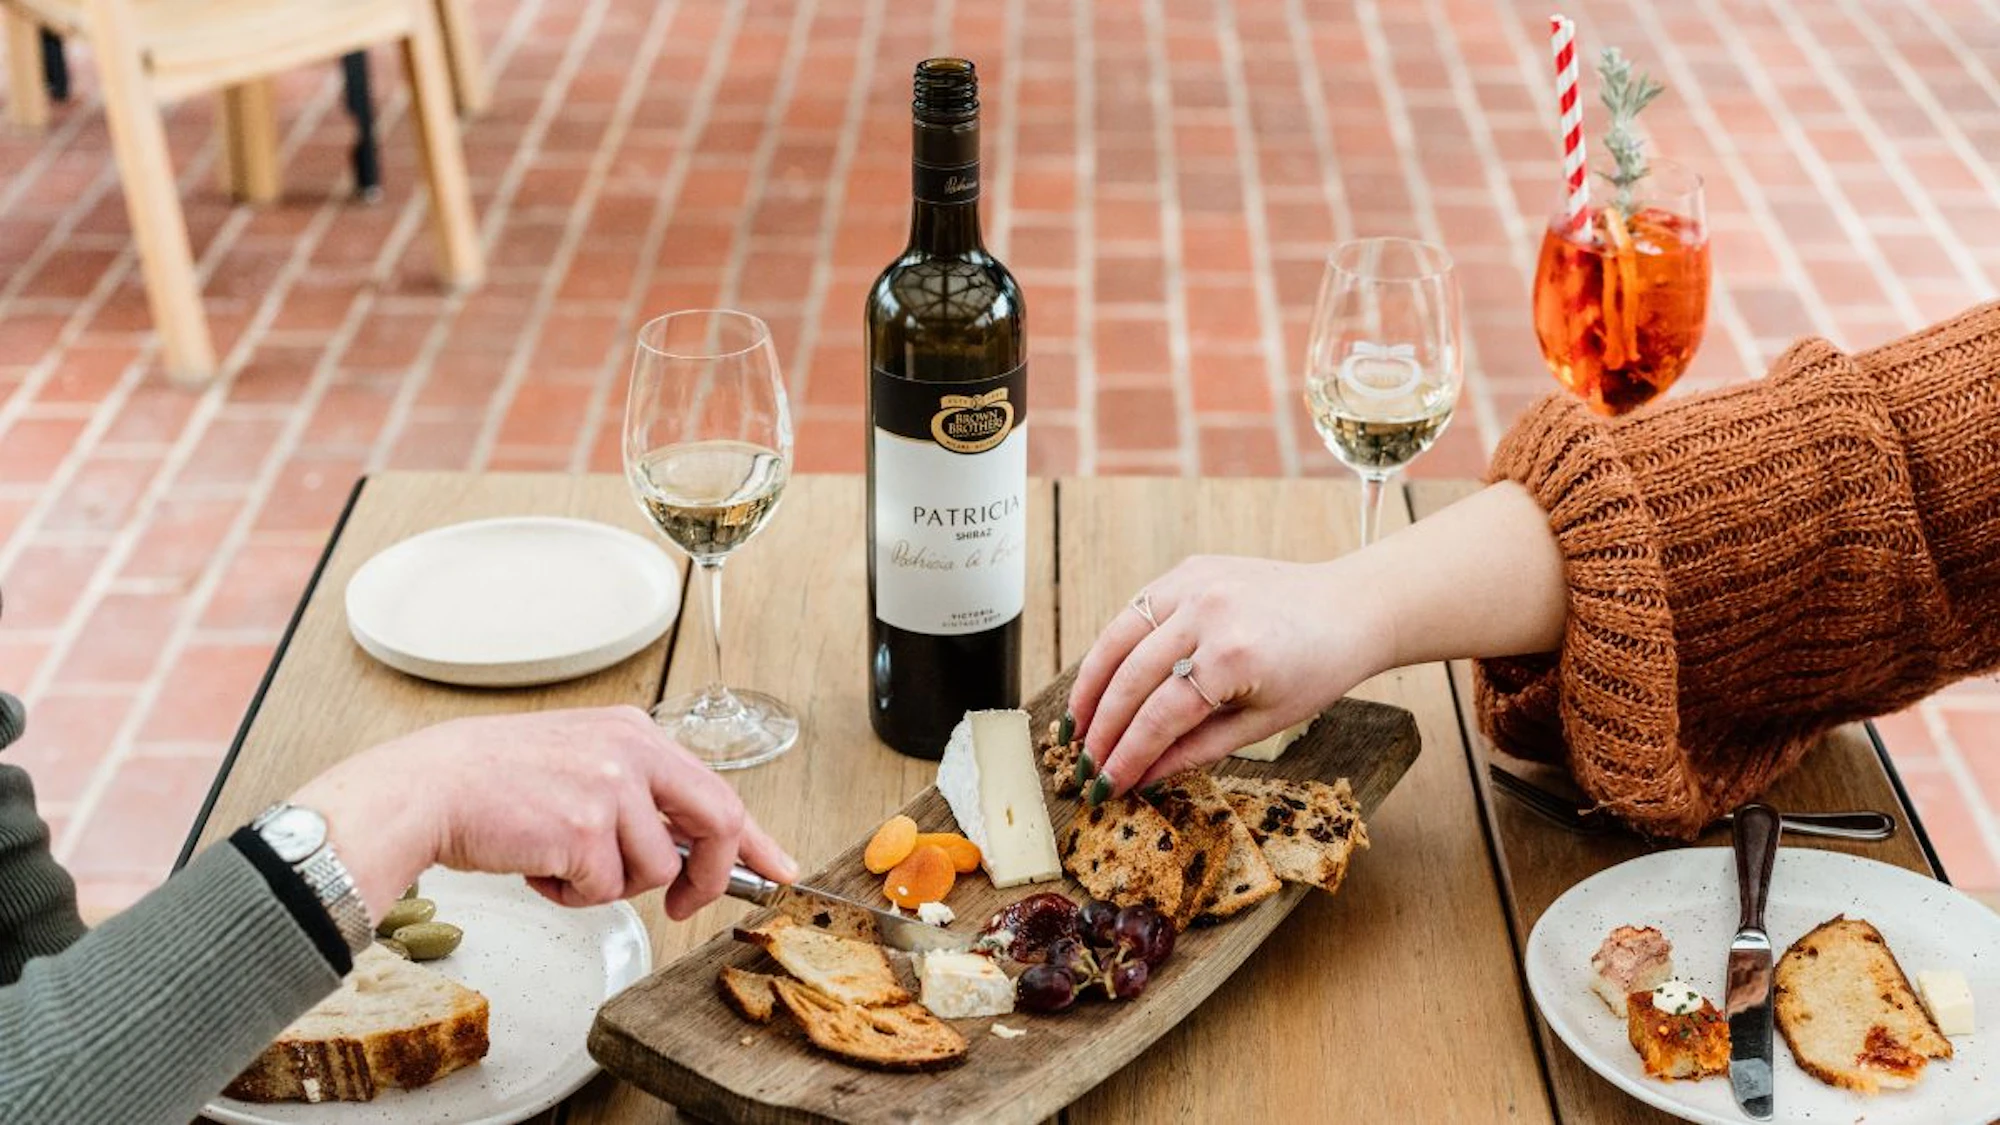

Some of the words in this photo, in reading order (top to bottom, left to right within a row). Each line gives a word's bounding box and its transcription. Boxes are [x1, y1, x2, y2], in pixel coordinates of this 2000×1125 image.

[955, 409, 998, 424] BROWN
[913, 495, 1019, 527] PATRICIA
[955, 528, 992, 541] SHIRAZ
